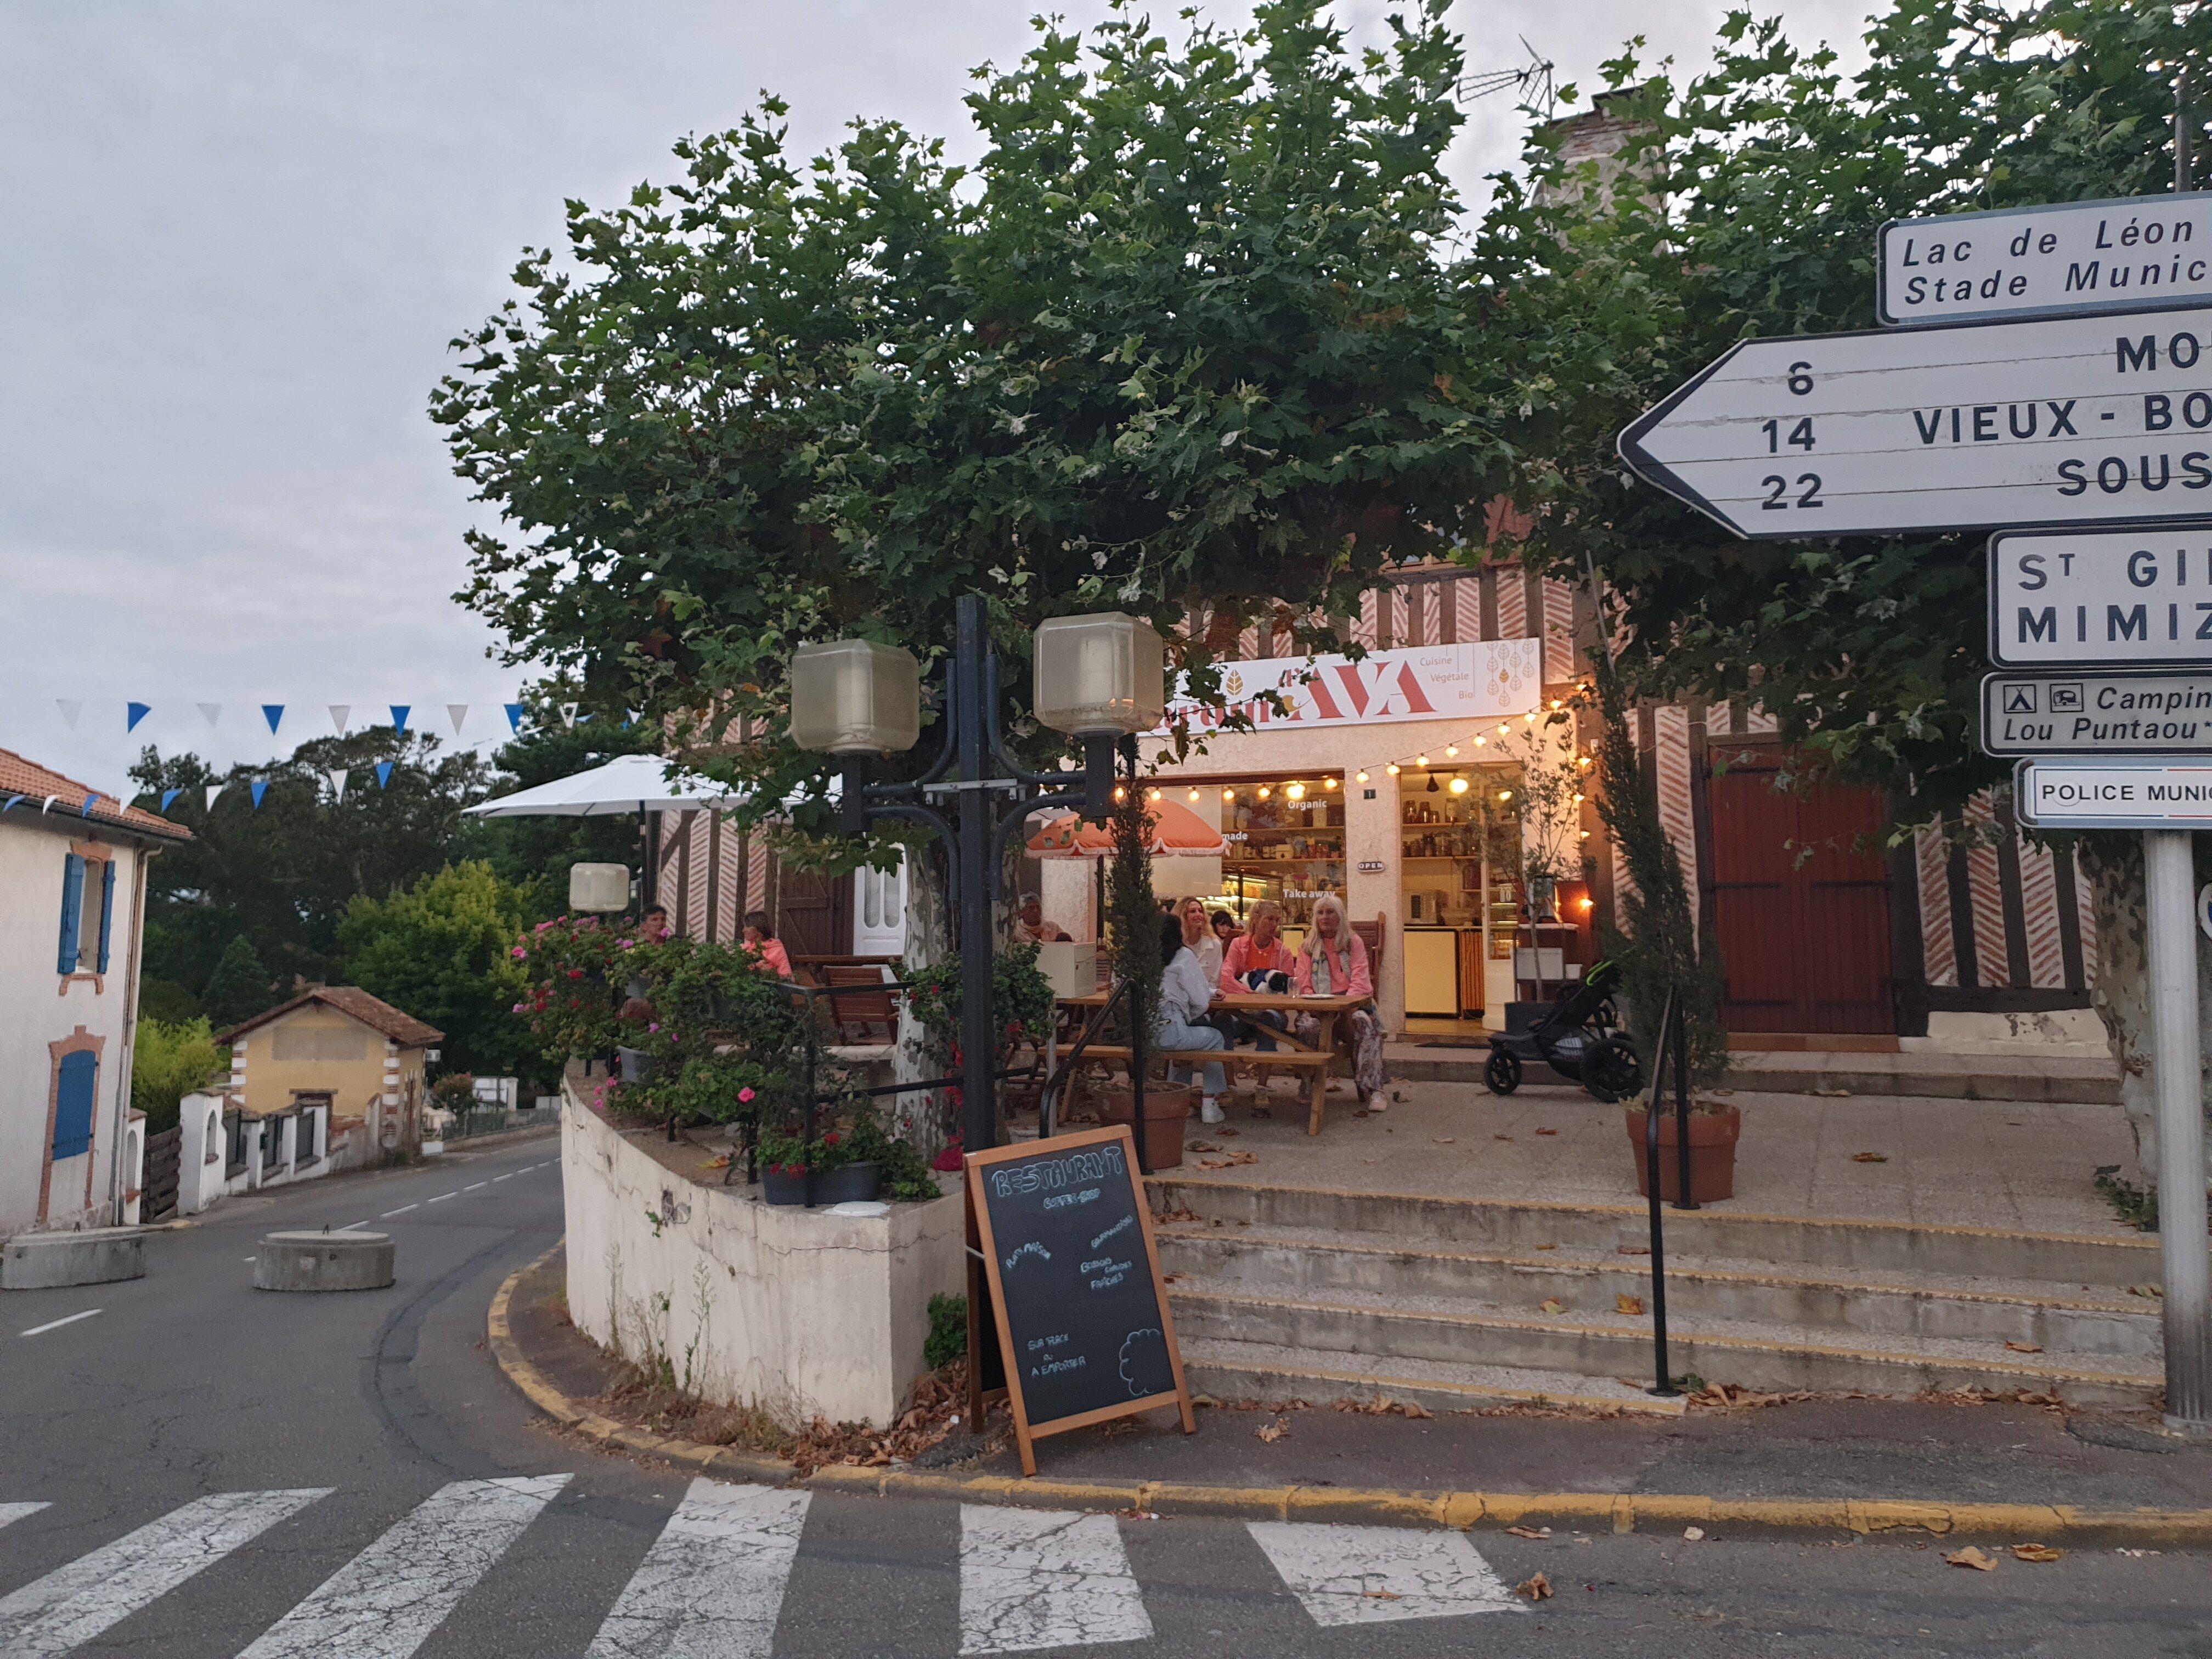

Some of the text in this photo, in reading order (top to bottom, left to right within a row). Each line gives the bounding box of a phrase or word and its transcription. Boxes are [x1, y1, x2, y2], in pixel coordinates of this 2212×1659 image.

[1903, 217, 2192, 267] Lac de Léon
[1905, 253, 2207, 305] Stade Munic
[2116, 331, 2212, 373] MO
[1788, 361, 1814, 396] 6
[1762, 417, 1816, 453] 14
[1913, 399, 2079, 445] VIEUX
[1761, 472, 1824, 510] 22
[2057, 451, 2212, 496] SOUS
[2127, 548, 2212, 588] GI
[2017, 602, 2212, 643] MIMIZ
[1419, 657, 1452, 667] Cuisine
[1430, 672, 1470, 684] Végétale
[1459, 690, 1474, 699] Bio
[2097, 686, 2212, 715] Campin
[2003, 717, 2197, 741] Lou Puntaou
[1288, 799, 1327, 810] Organic
[2042, 785, 2212, 801] POLICE MUNI
[1358, 862, 1384, 871] OPEN
[1283, 889, 1335, 899] Take away
[992, 1146, 1122, 1197] RESTAURANT
